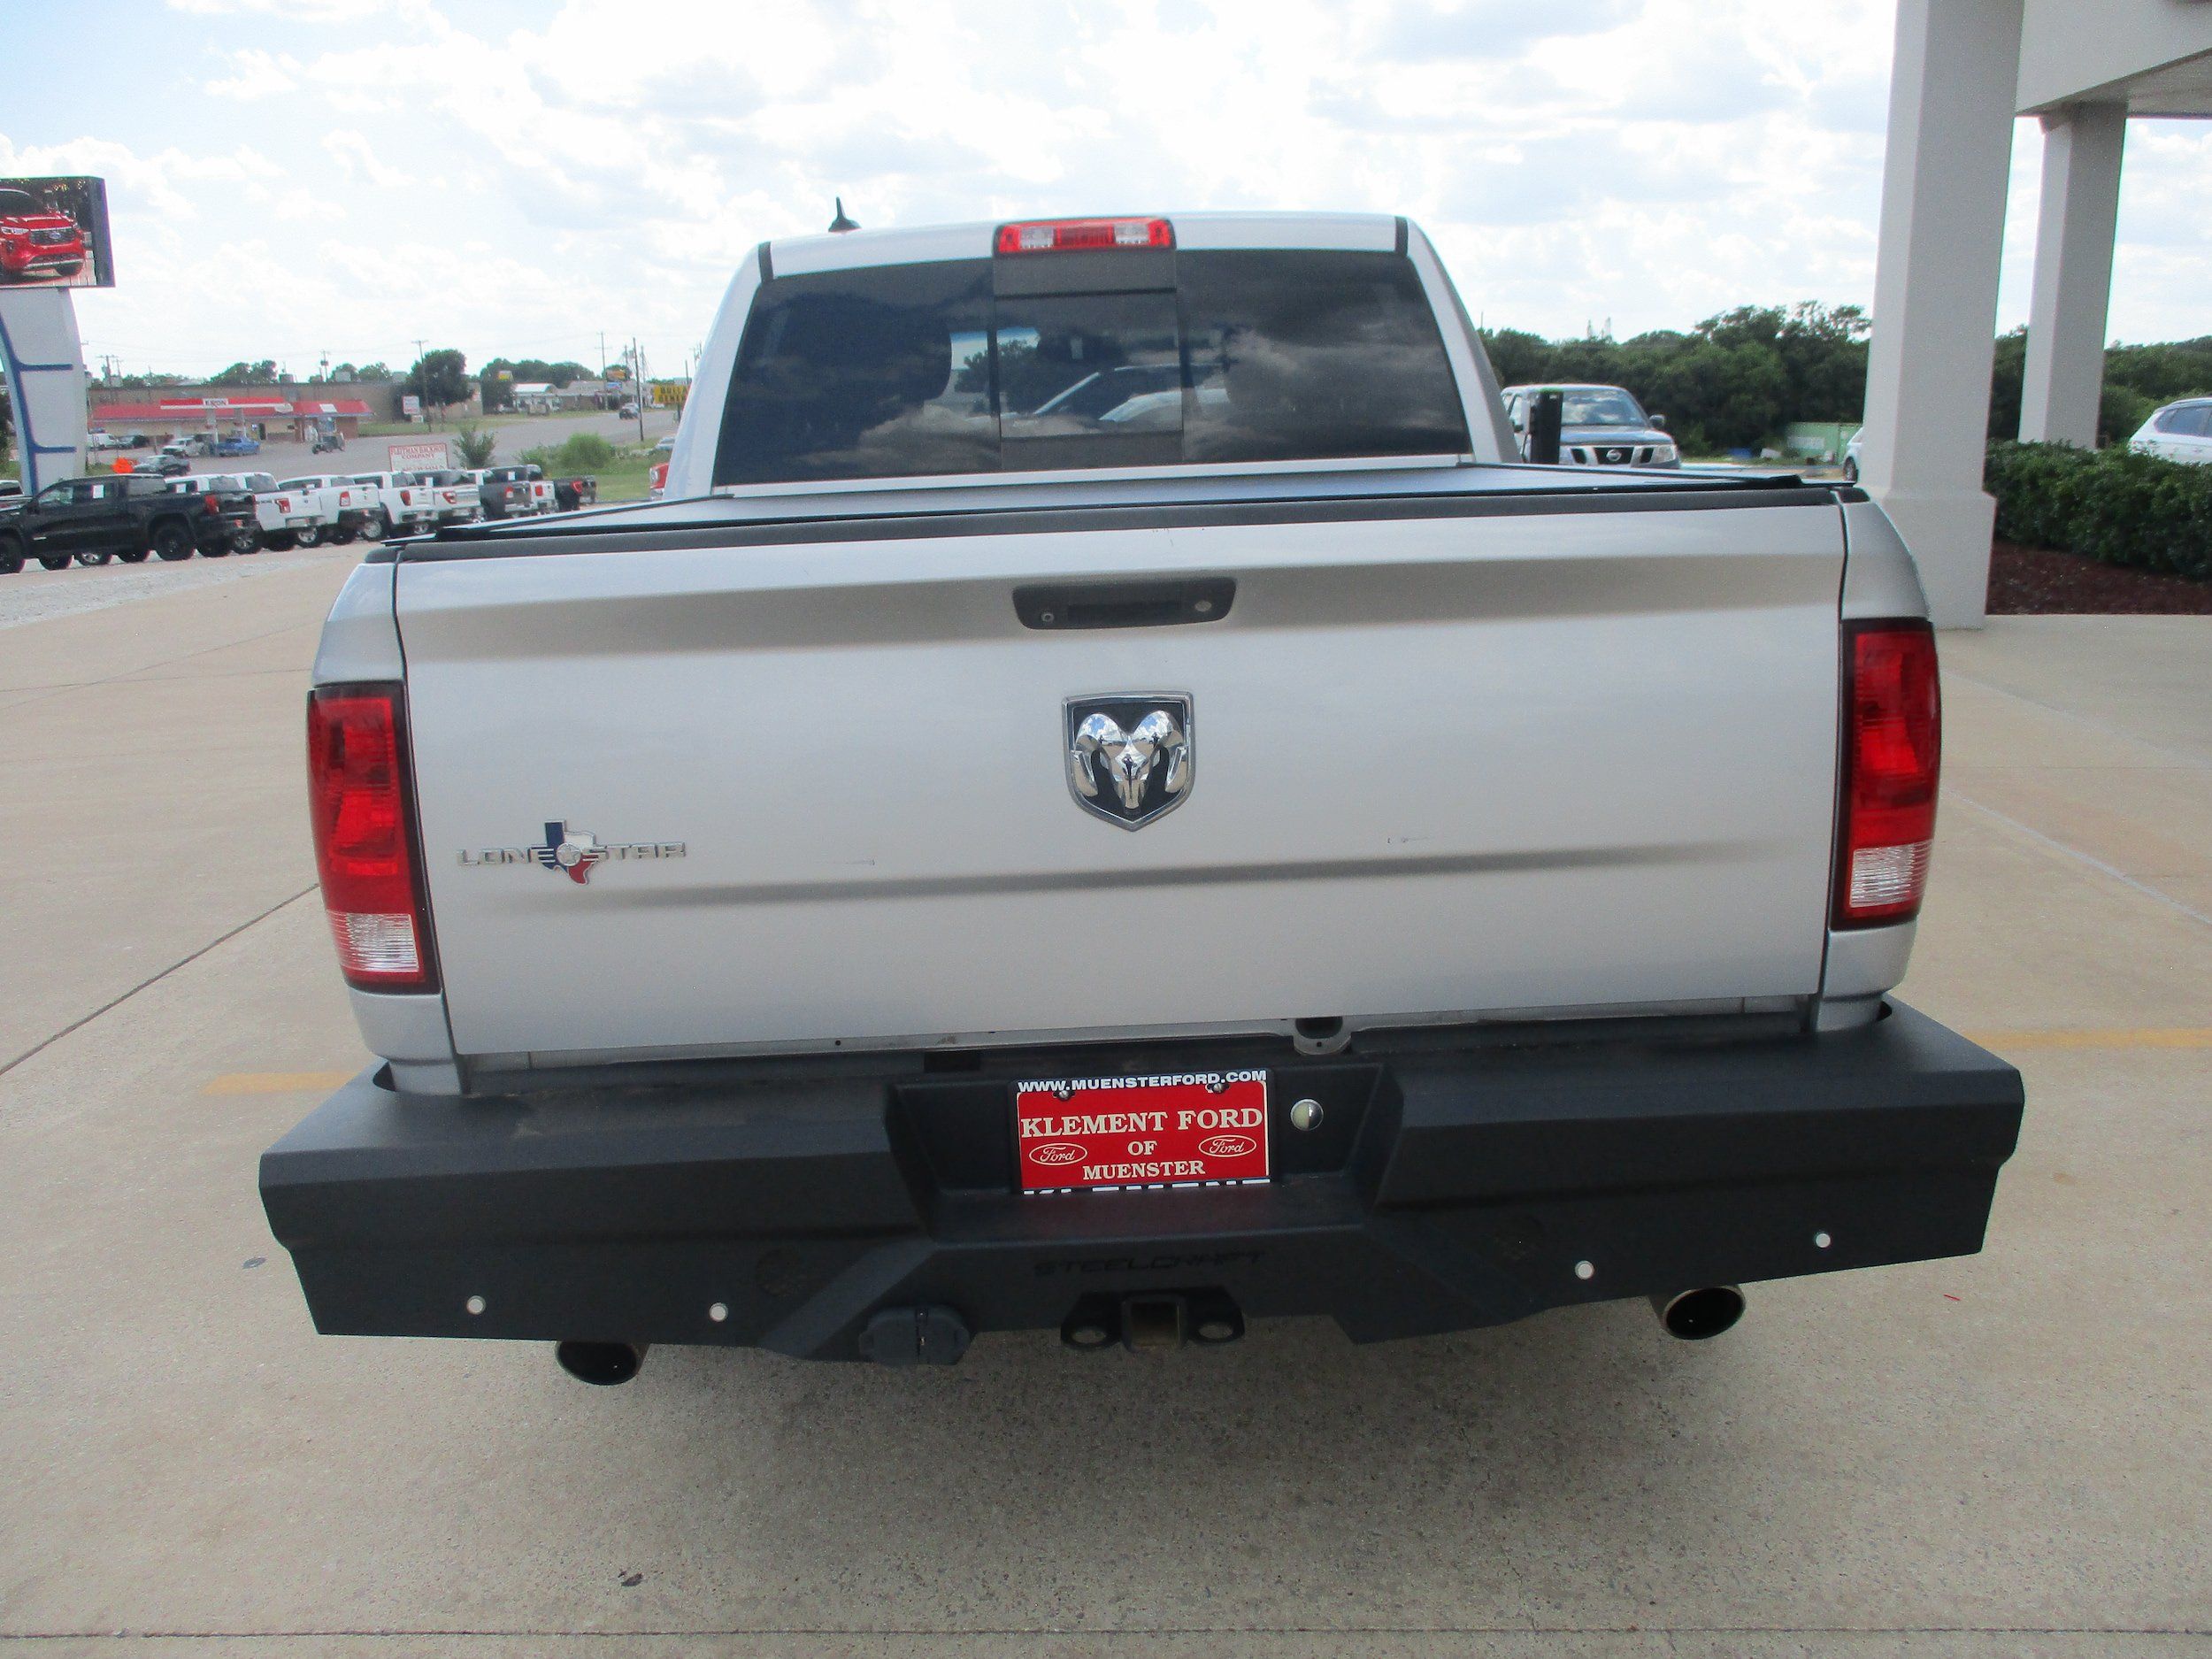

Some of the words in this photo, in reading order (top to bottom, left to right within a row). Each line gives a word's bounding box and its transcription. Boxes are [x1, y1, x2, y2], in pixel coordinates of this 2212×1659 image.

[457, 845, 556, 866] LONE
[580, 841, 686, 863] STAR
[1018, 1070, 1267, 1093] WWW.MUENSTERFORD.COM
[1020, 1111, 1168, 1139] KLEMENT
[1177, 1108, 1263, 1130] FORD
[1039, 1146, 1075, 1162] Ford
[1127, 1141, 1157, 1156] OF
[1209, 1138, 1245, 1154] Ford
[1082, 1160, 1206, 1180] MUENSTER
